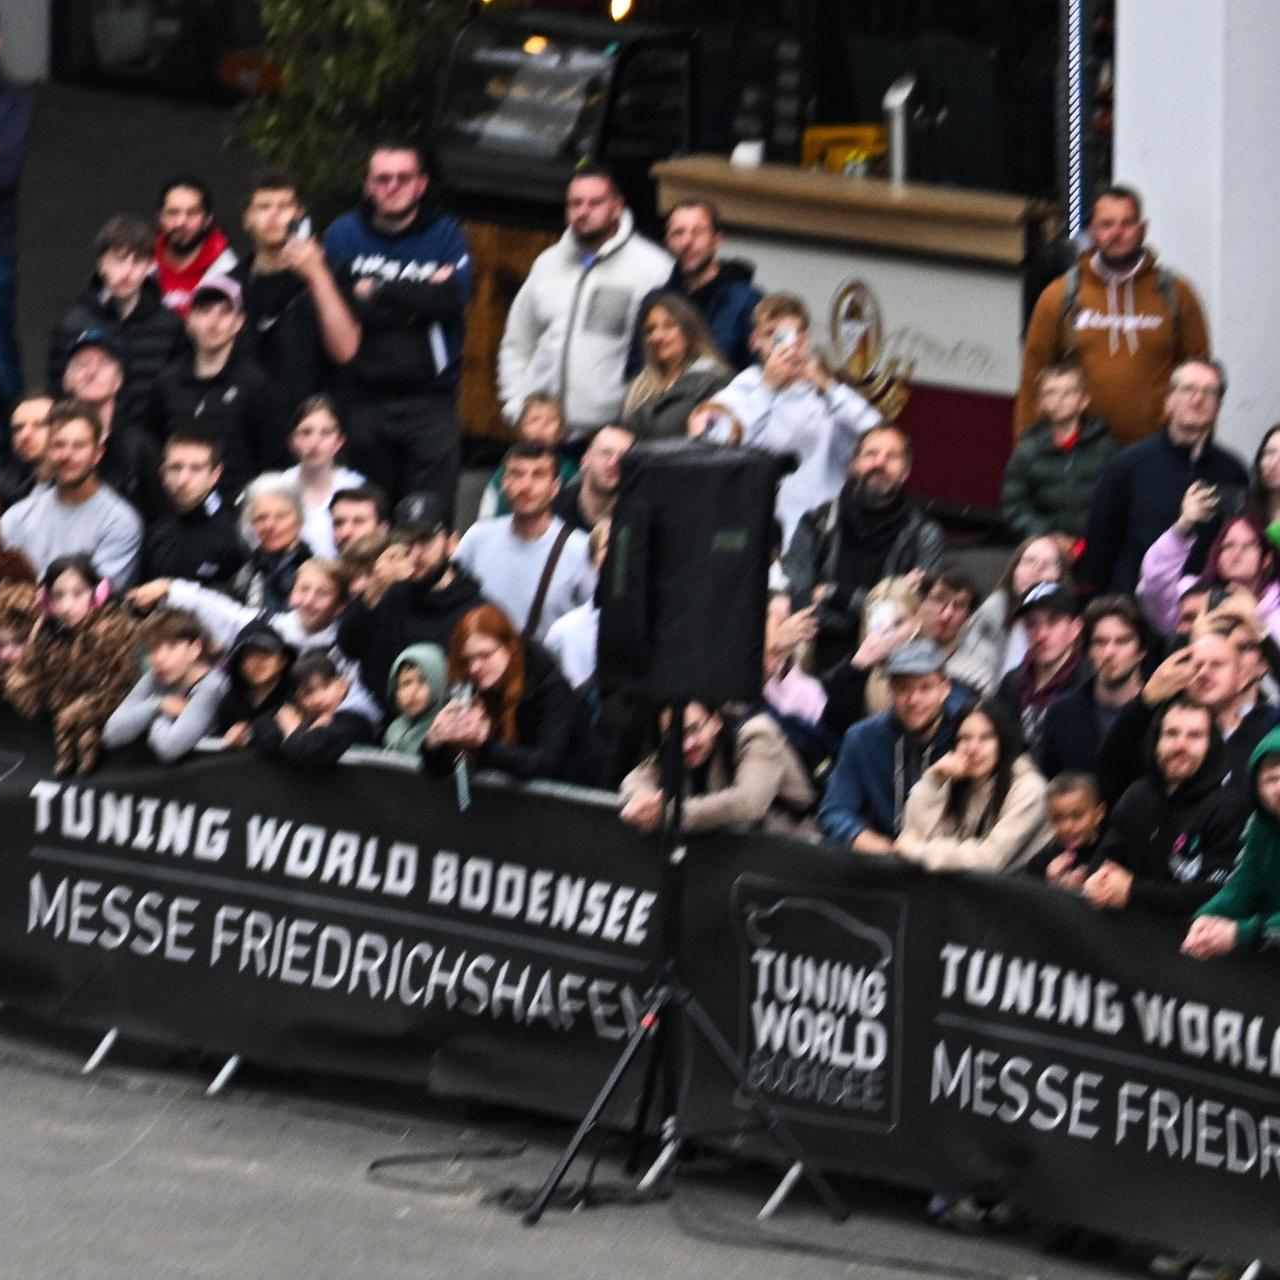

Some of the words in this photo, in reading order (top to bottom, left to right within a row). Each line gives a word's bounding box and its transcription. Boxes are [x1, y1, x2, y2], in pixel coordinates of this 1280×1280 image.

[29, 780, 231, 862] TUNING
[244, 813, 418, 897] WORLD
[428, 851, 659, 946] BODENSEE
[27, 870, 202, 963] MESSE
[210, 906, 657, 1041] FRIEDRICHSHAFEN
[751, 948, 887, 1019] TUNING
[940, 944, 1124, 1036] TUNING
[750, 997, 888, 1070] WORLD
[930, 1039, 1103, 1140] MESSE
